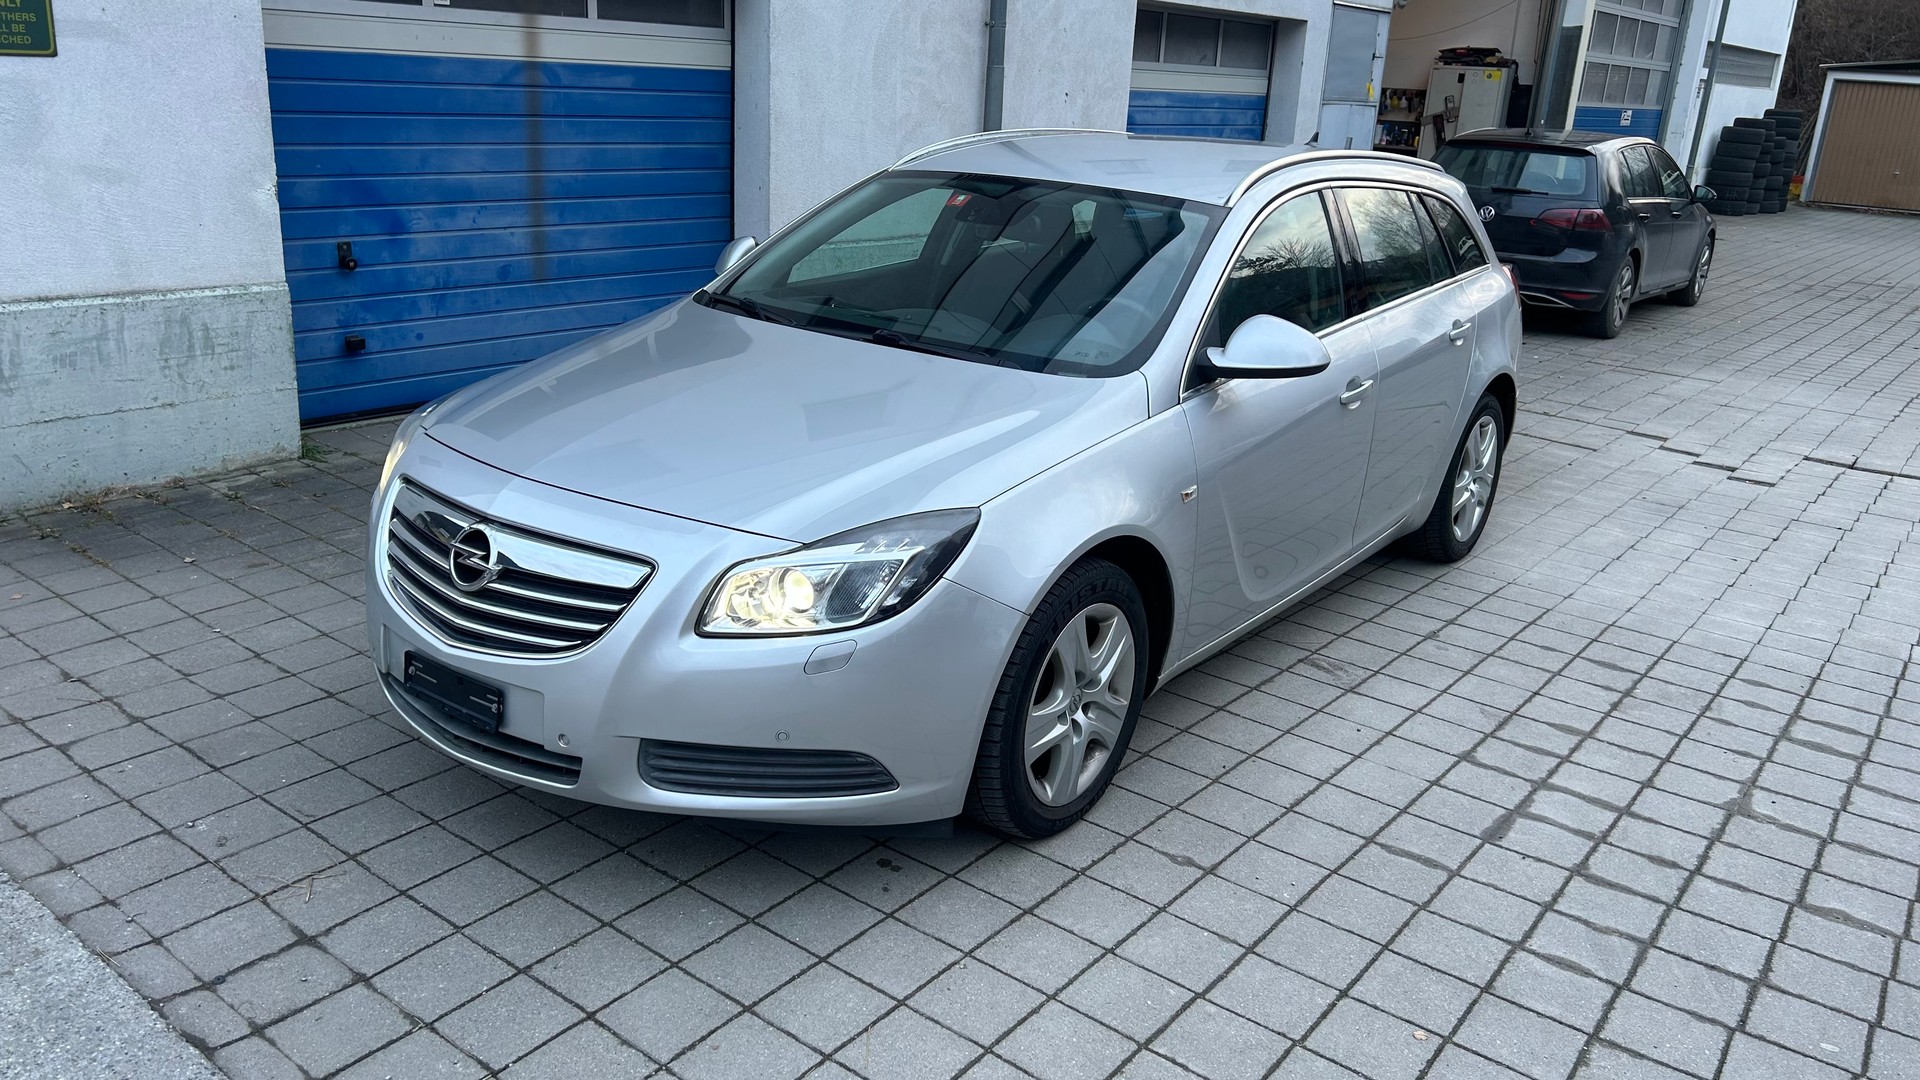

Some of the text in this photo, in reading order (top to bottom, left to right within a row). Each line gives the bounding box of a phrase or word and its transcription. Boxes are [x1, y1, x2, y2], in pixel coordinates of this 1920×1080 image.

[0, 12, 37, 22] THERS
[11, 23, 26, 33] BE
[0, 35, 32, 44] CHED
